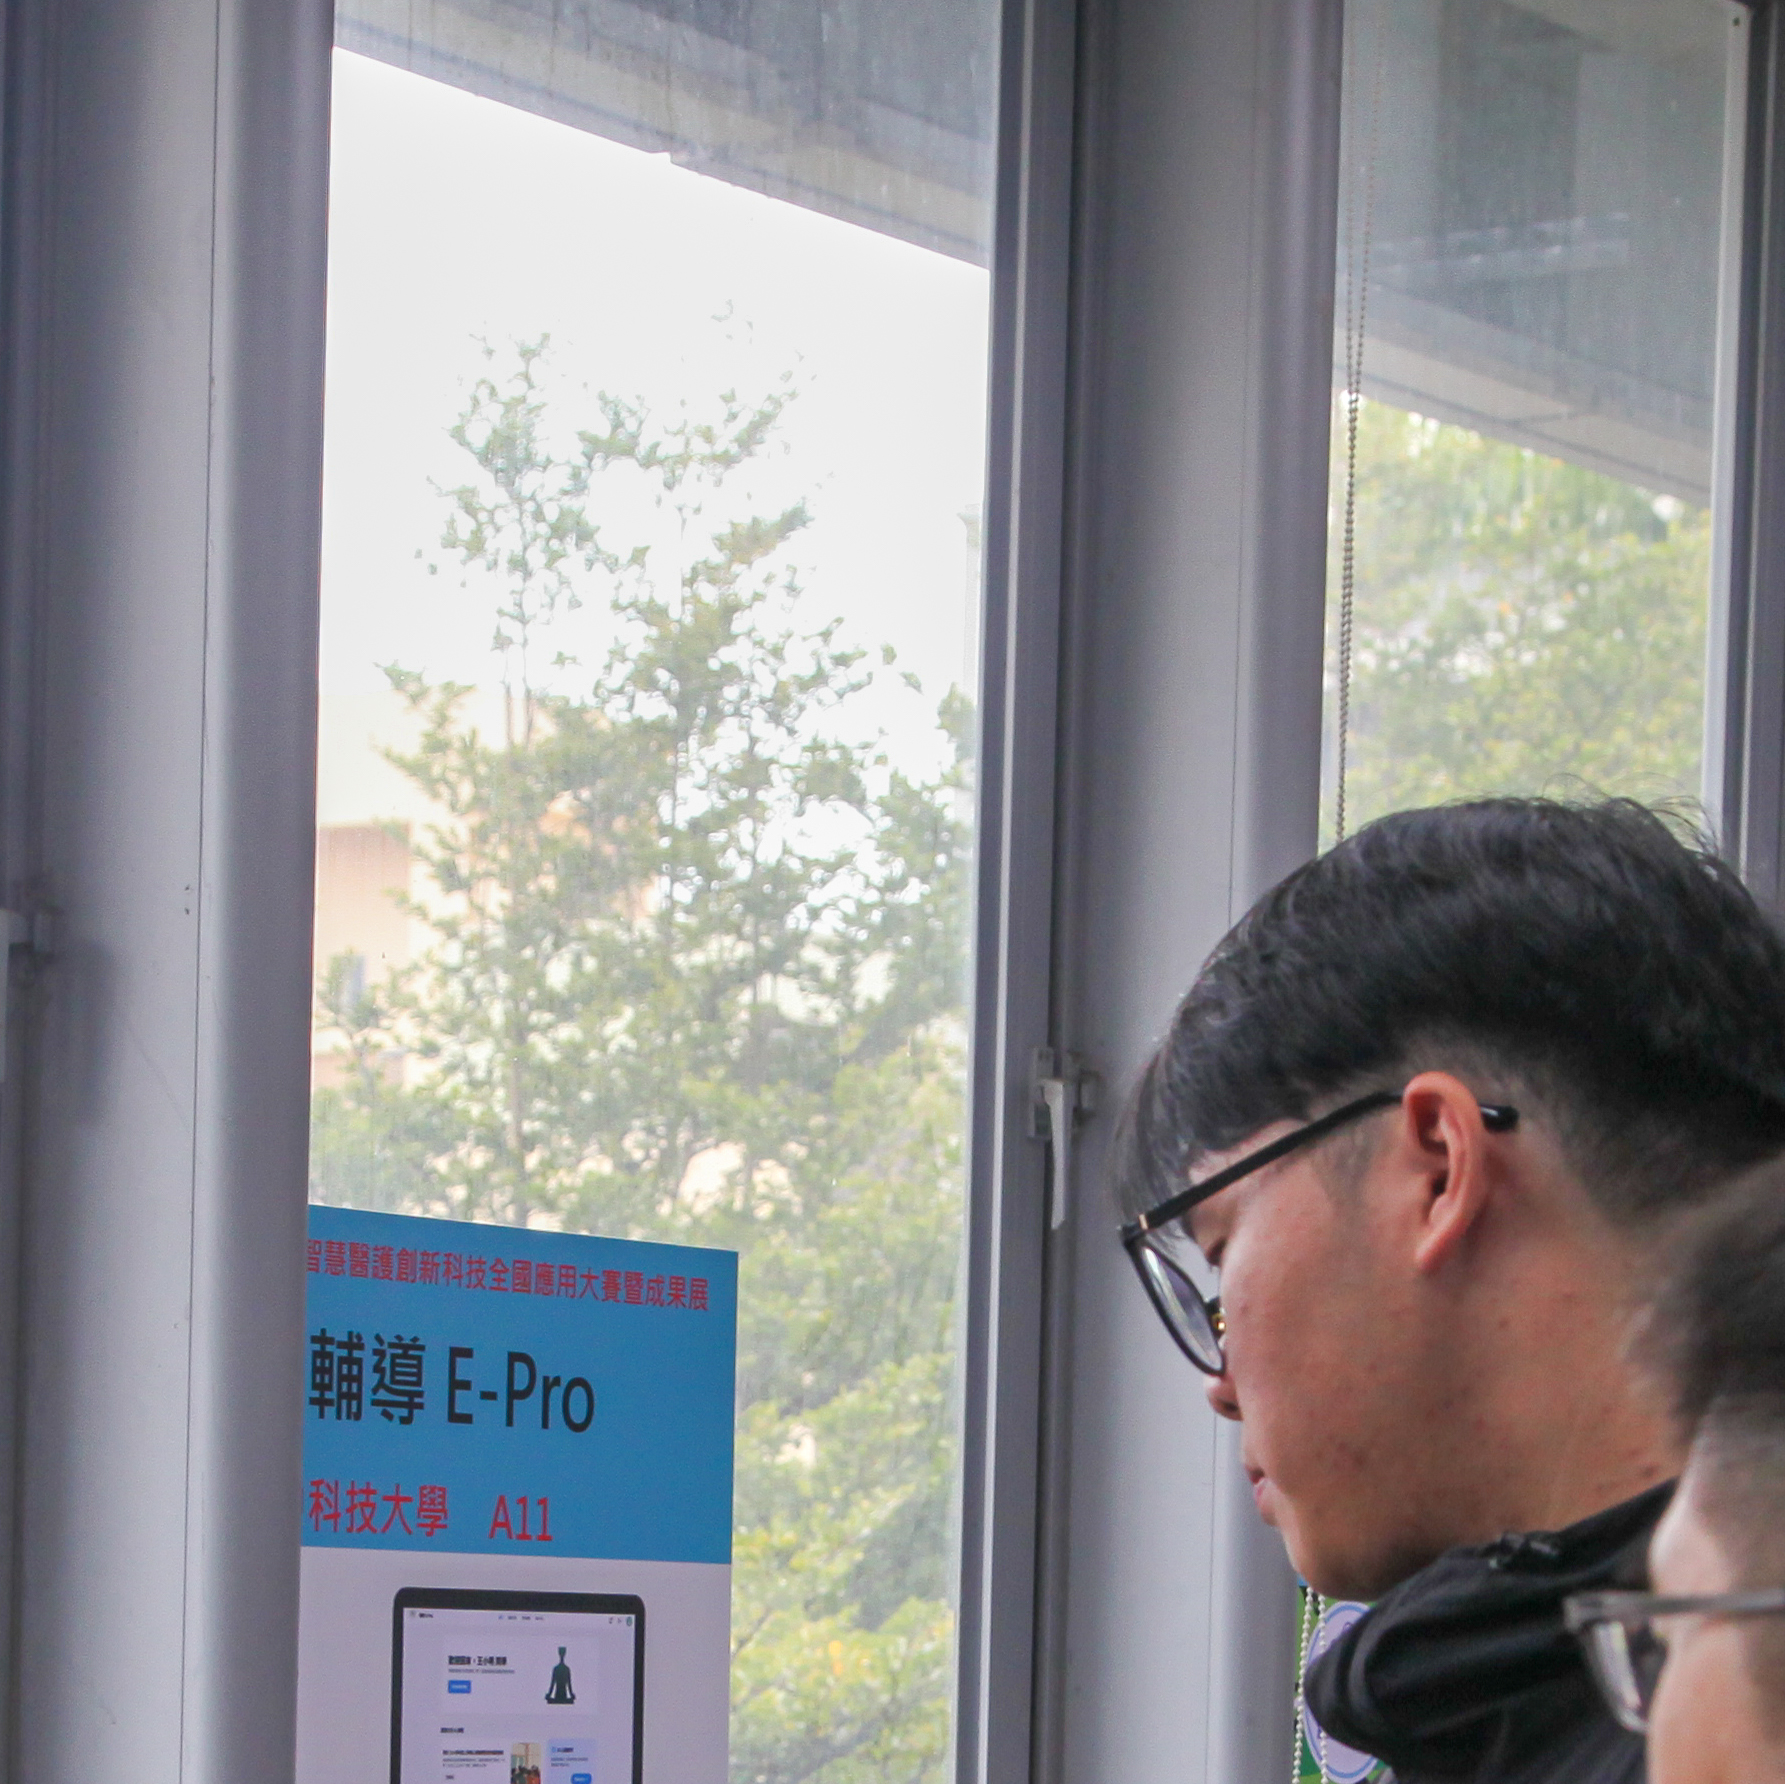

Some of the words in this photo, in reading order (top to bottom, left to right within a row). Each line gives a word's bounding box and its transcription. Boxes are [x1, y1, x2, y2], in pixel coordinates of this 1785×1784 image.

[309, 1328, 426, 1426] 輔導
[447, 1346, 595, 1433] E-Pro
[309, 1479, 449, 1537] 科技大學
[488, 1495, 553, 1541] A11
